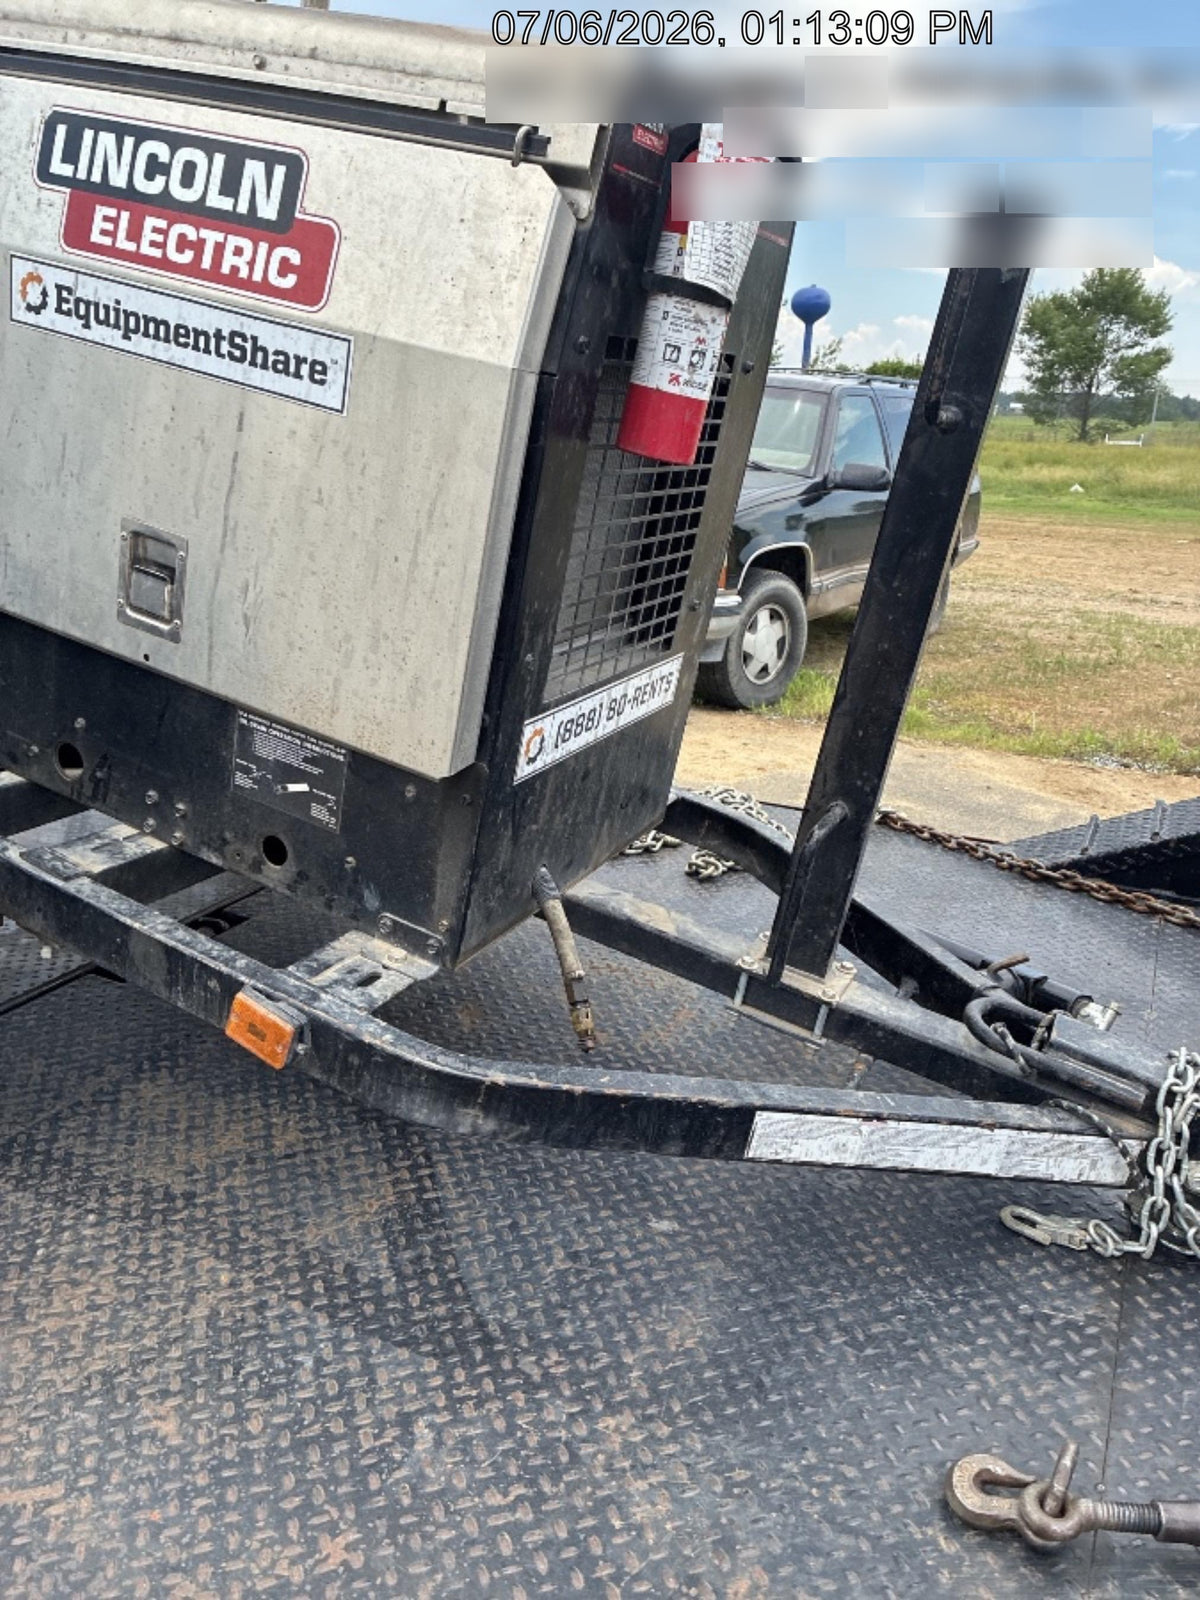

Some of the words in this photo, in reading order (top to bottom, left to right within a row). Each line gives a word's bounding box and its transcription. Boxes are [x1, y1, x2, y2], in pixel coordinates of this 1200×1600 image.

[49, 123, 287, 221] LINCOLN
[90, 204, 301, 289] ELECTRIC
[54, 282, 330, 387] EquipmentShare
[554, 701, 604, 749] (888)
